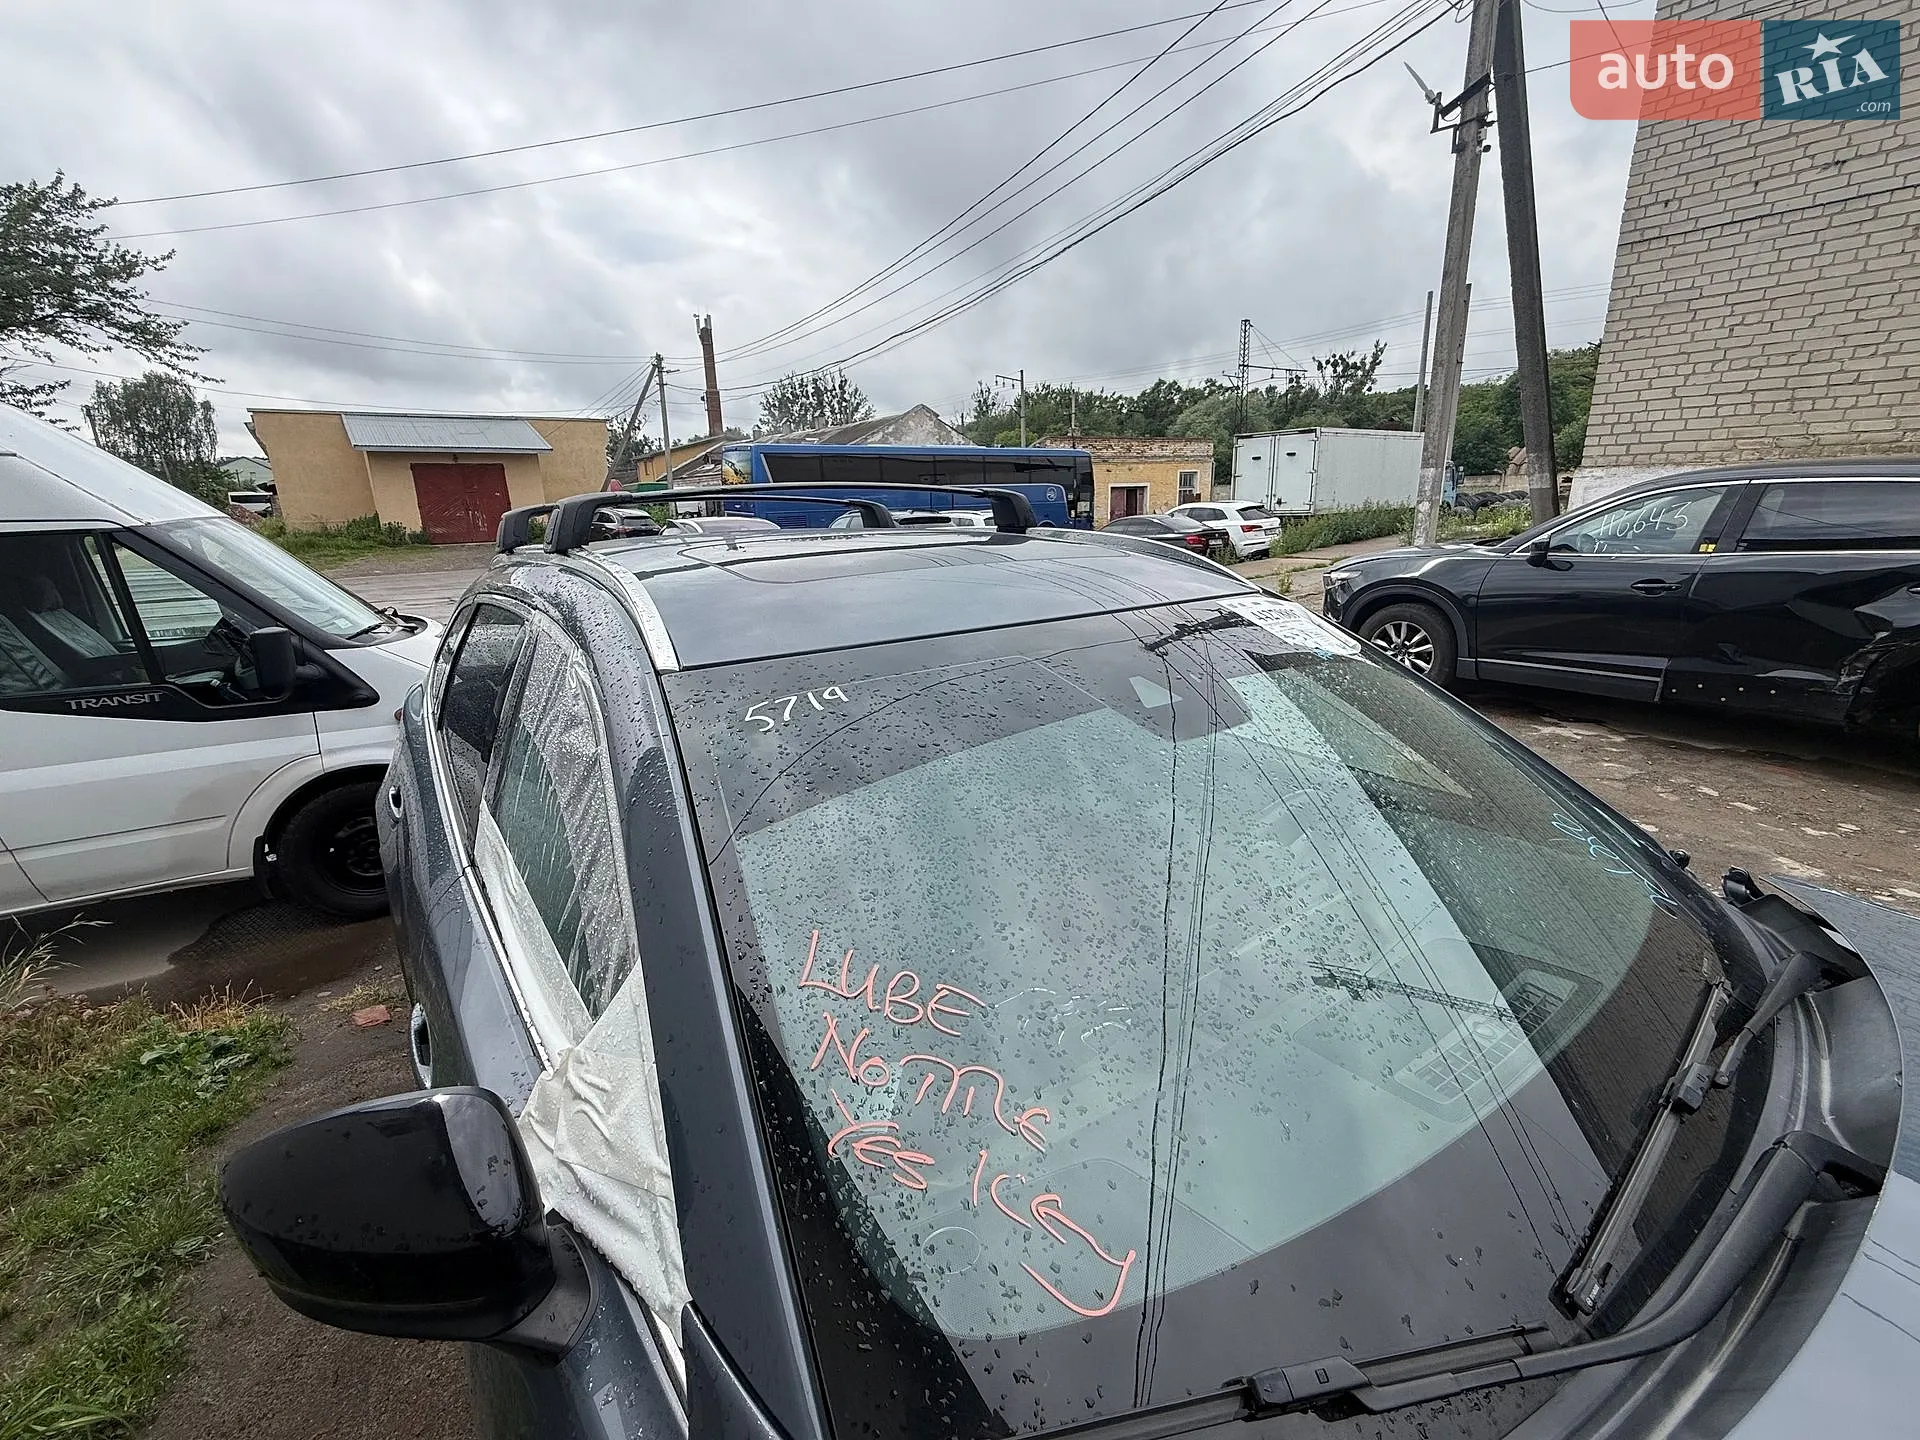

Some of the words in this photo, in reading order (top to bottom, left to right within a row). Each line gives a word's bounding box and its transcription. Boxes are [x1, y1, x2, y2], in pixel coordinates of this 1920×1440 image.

[66, 692, 164, 710] TRANSIT
[744, 686, 850, 732] 5719
[799, 929, 988, 1037] LUBE
